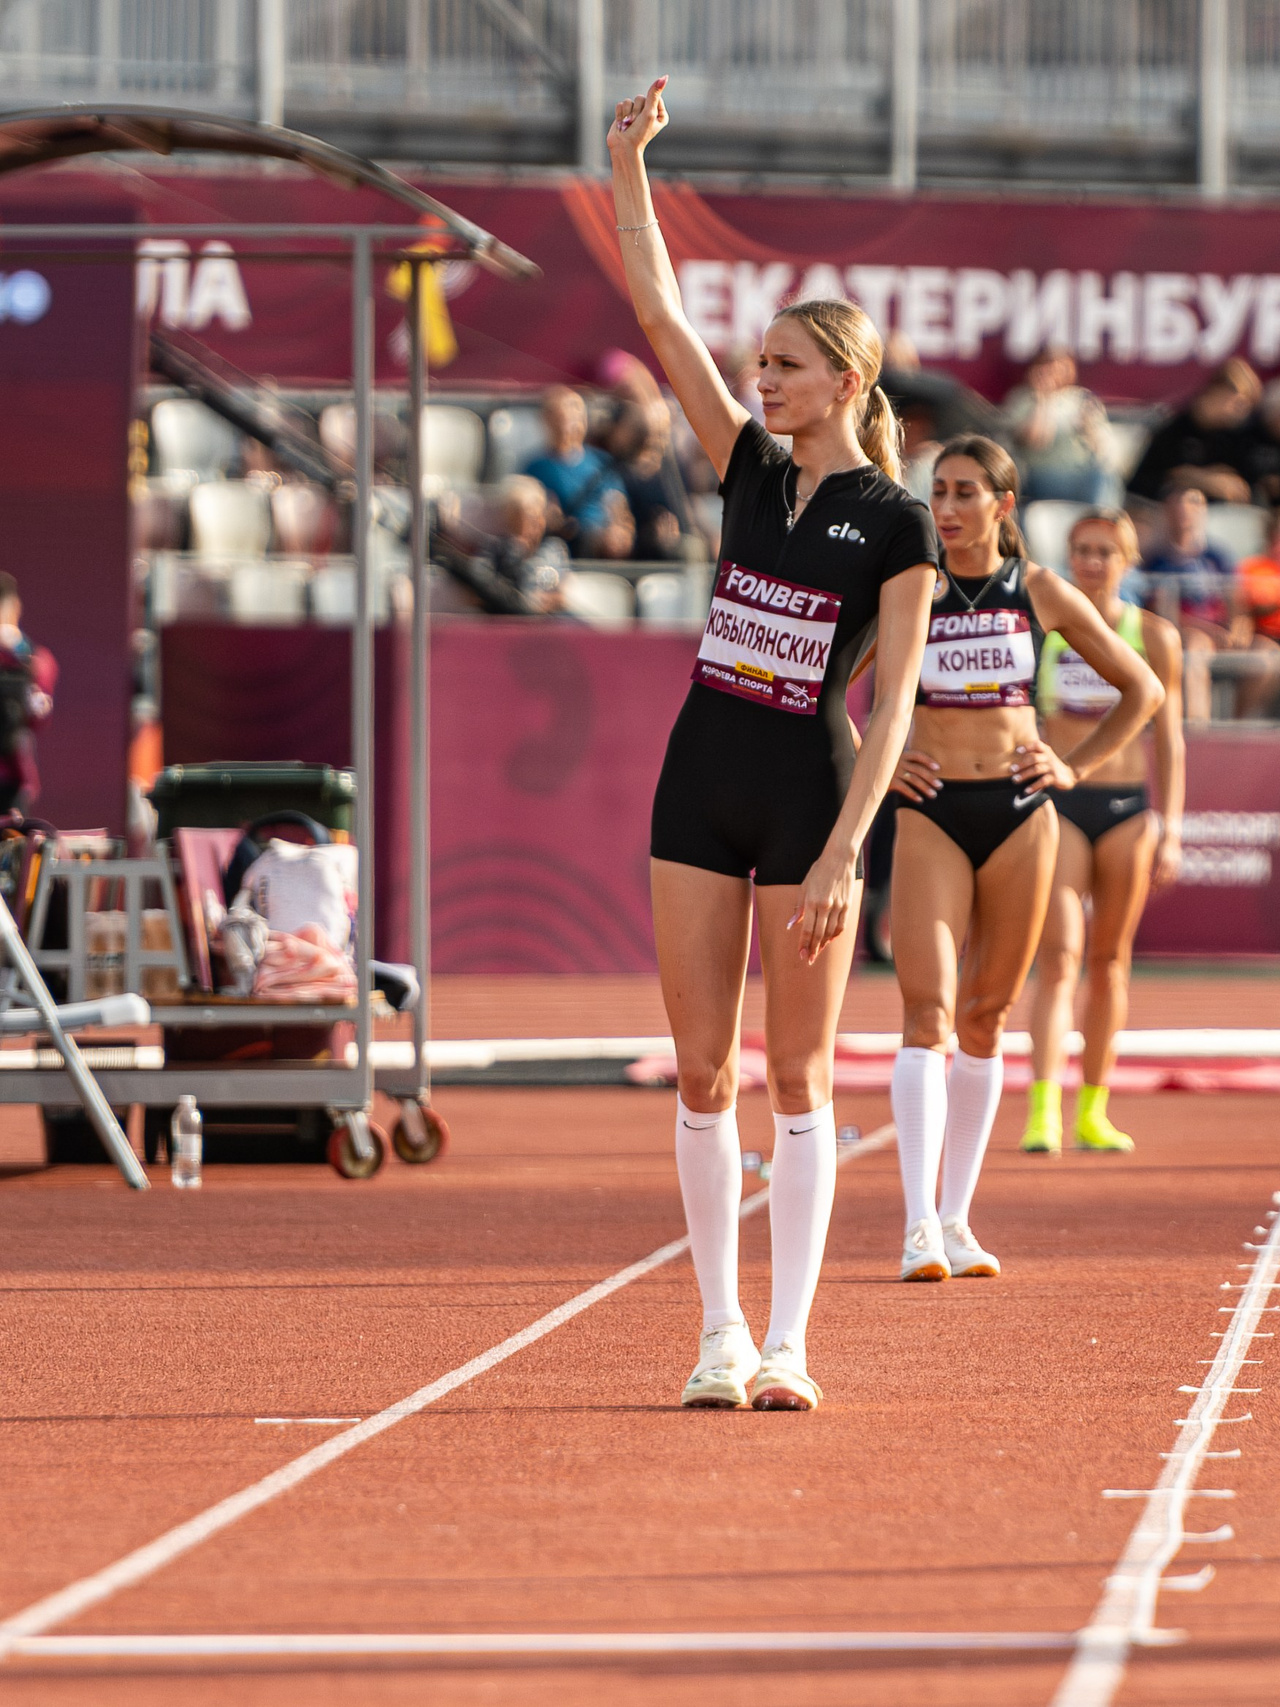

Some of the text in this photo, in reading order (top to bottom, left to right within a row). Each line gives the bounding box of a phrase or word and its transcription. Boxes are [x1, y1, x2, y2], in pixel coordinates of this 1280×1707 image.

[726, 569, 828, 617] FONBET
[930, 612, 1020, 636] FONBET
[705, 607, 830, 669] КОБЫЛЯНСКИХ
[740, 664, 768, 678] ФИНАЛ
[938, 647, 1016, 672] КОНЕВА
[738, 676, 774, 694] СПОРТА
[781, 695, 807, 709] ВФЛА
